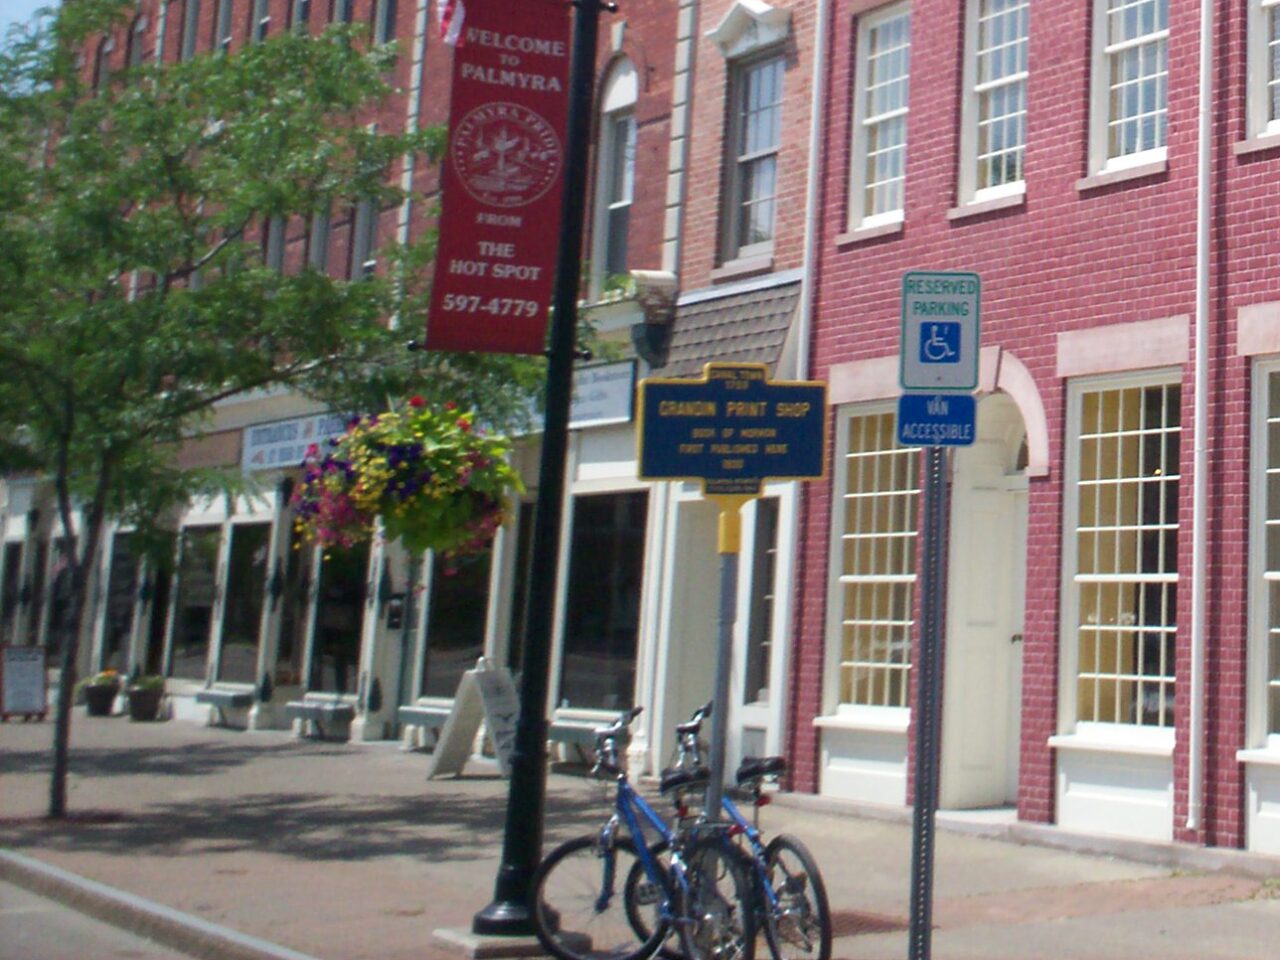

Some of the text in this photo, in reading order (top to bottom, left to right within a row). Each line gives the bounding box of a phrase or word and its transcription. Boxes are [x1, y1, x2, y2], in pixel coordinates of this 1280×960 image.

[499, 54, 520, 67] TO
[461, 62, 562, 92] PALMYRA
[476, 212, 523, 228] FROM
[478, 240, 515, 258] THE
[449, 259, 542, 281] HOT SPOT
[907, 279, 976, 295] RESERVED
[442, 294, 539, 318] 597-4779
[913, 301, 969, 316] PARKING
[726, 401, 767, 417] PRINT
[776, 402, 811, 417] SHOP
[926, 400, 949, 415] VAN
[903, 423, 972, 439] ACCESSIBLE
